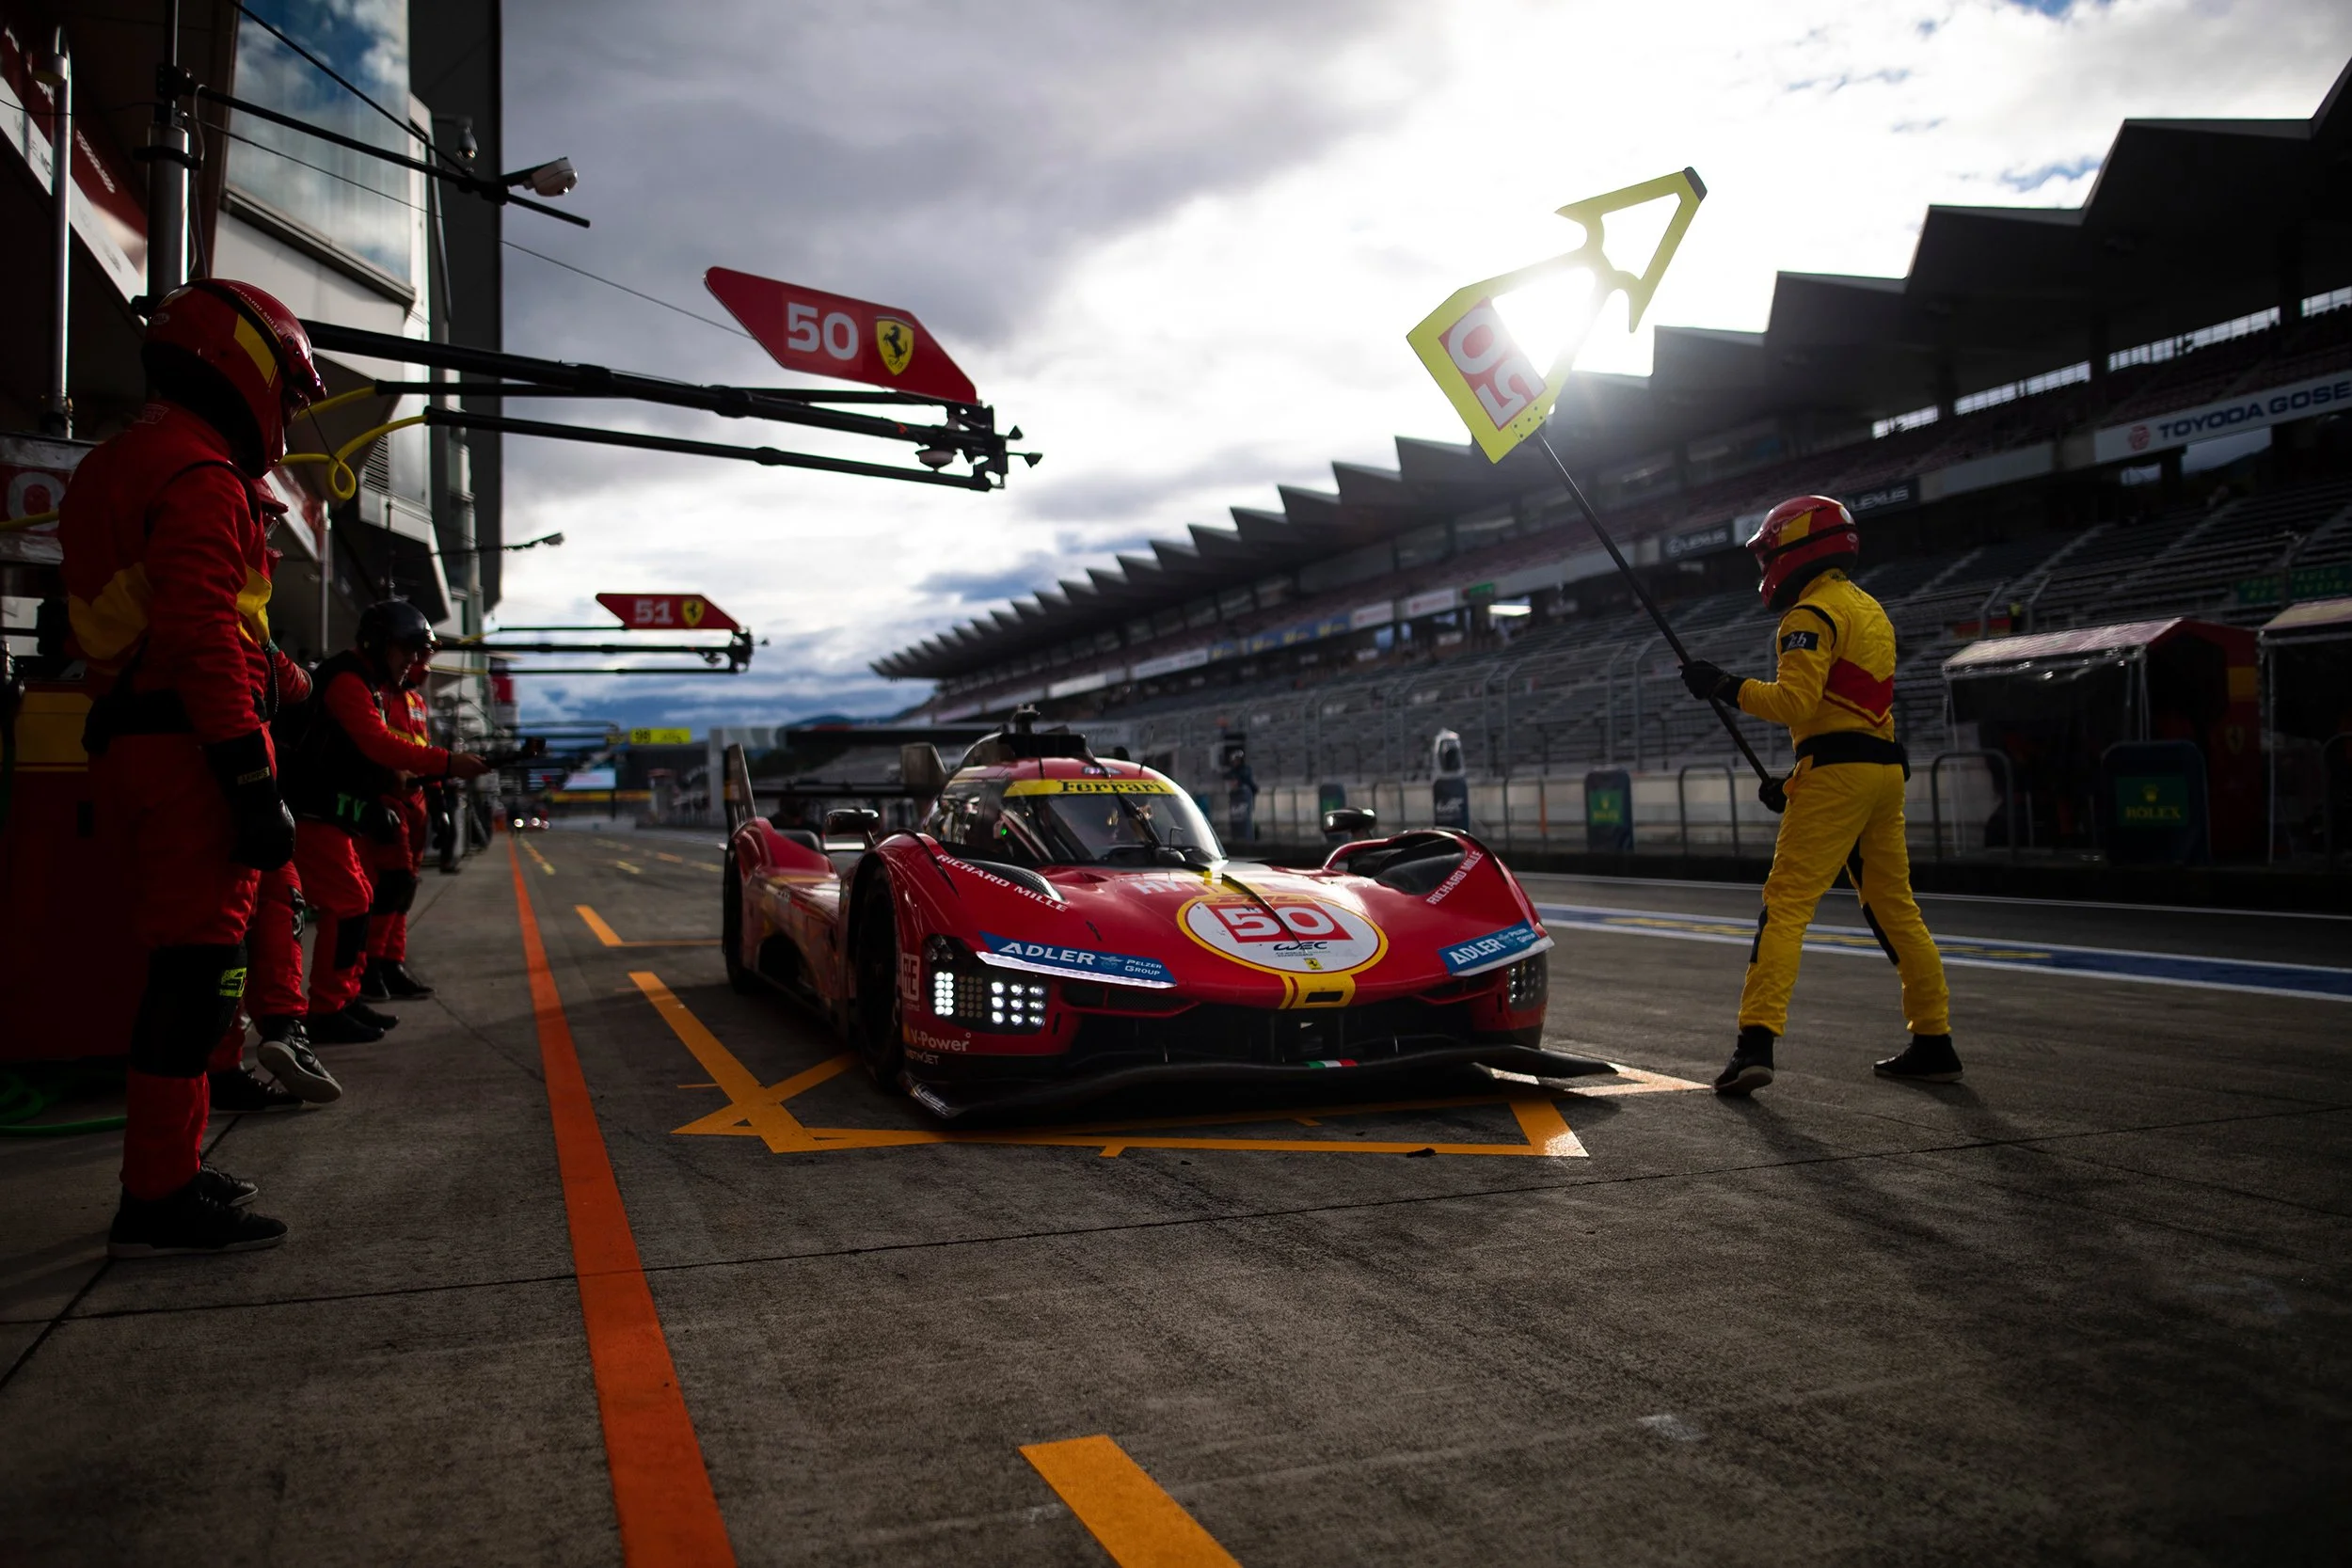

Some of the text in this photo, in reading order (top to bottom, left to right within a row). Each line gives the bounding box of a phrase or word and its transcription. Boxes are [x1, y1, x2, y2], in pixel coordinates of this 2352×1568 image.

[787, 301, 860, 361] 50
[1448, 307, 1546, 430] 50
[2158, 402, 2265, 438] TOYODA
[1852, 485, 1909, 513] LEXUS
[1683, 530, 1727, 552] LEXUS
[633, 598, 675, 625] 51
[1061, 781, 1167, 793] Ferrari
[336, 791, 369, 823] TV
[935, 854, 1069, 912] RICHARD MILLE
[1425, 849, 1485, 905] RICHARD MILLE
[1216, 906, 1335, 937] 50
[998, 942, 1096, 966] ADLER
[1273, 941, 1328, 951] WEC
[1448, 938, 1507, 965] ADLER
